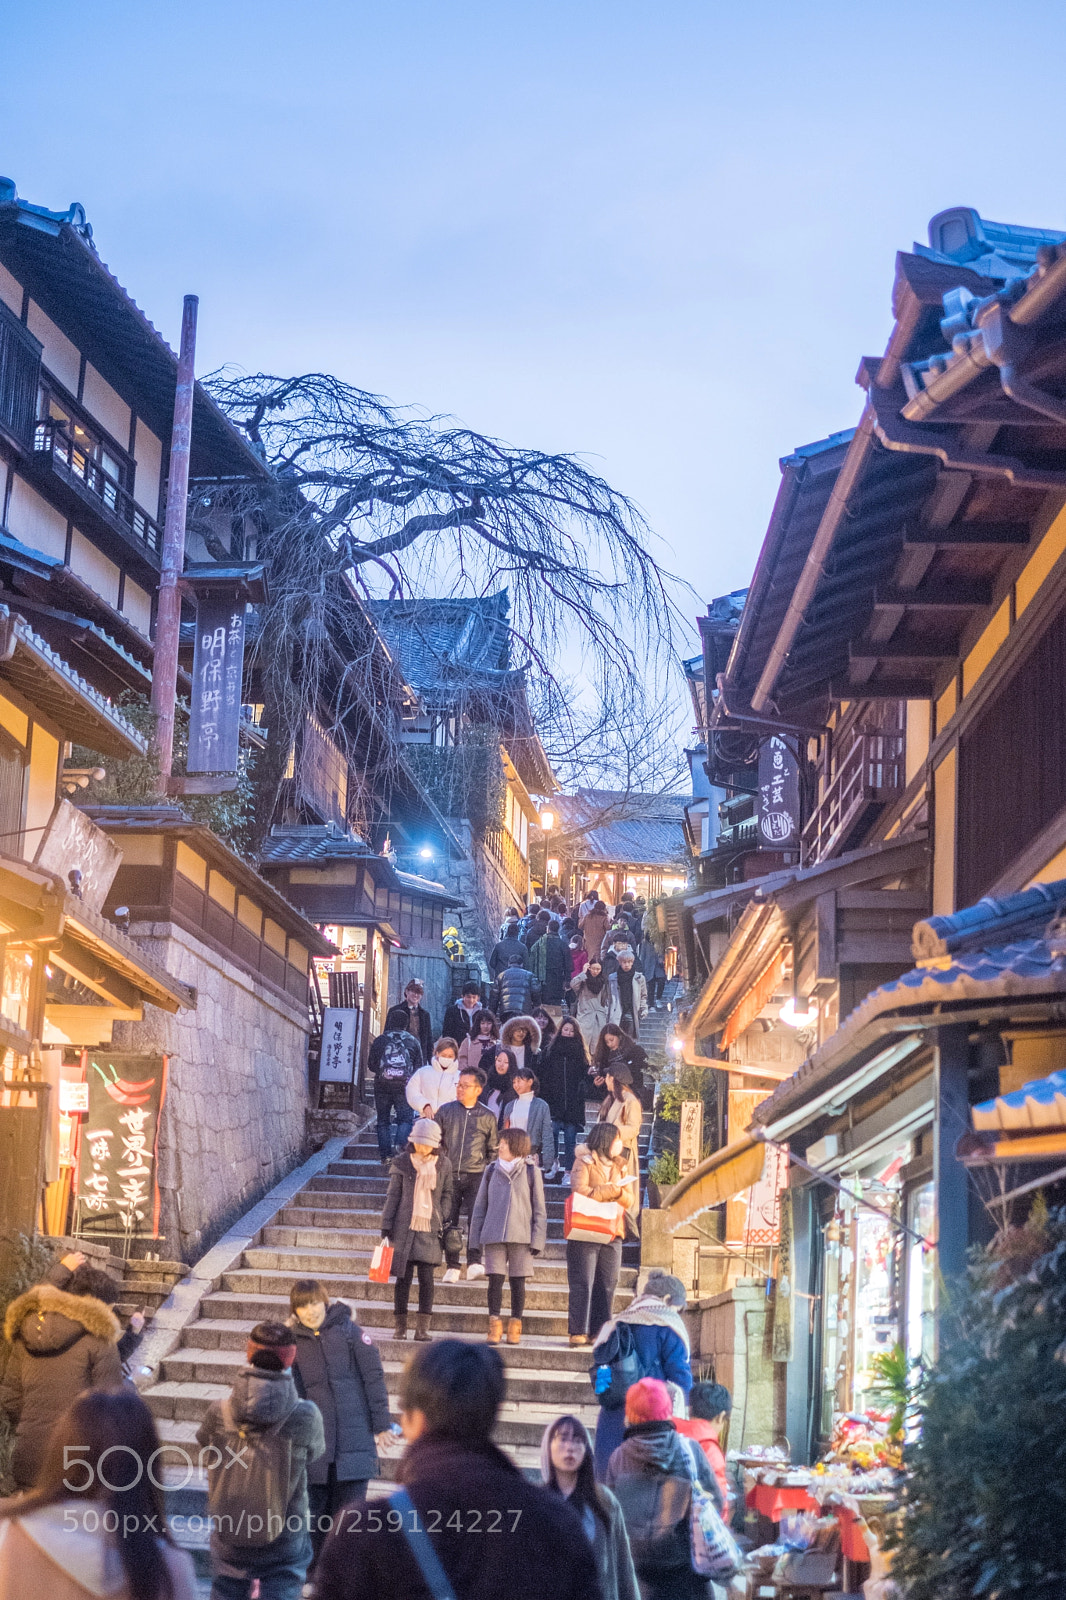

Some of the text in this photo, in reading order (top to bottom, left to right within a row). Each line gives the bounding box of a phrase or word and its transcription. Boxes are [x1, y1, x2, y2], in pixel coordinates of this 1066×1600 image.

[199, 626, 226, 750] 明保野亭
[116, 1106, 154, 1227] 世界一辛い
